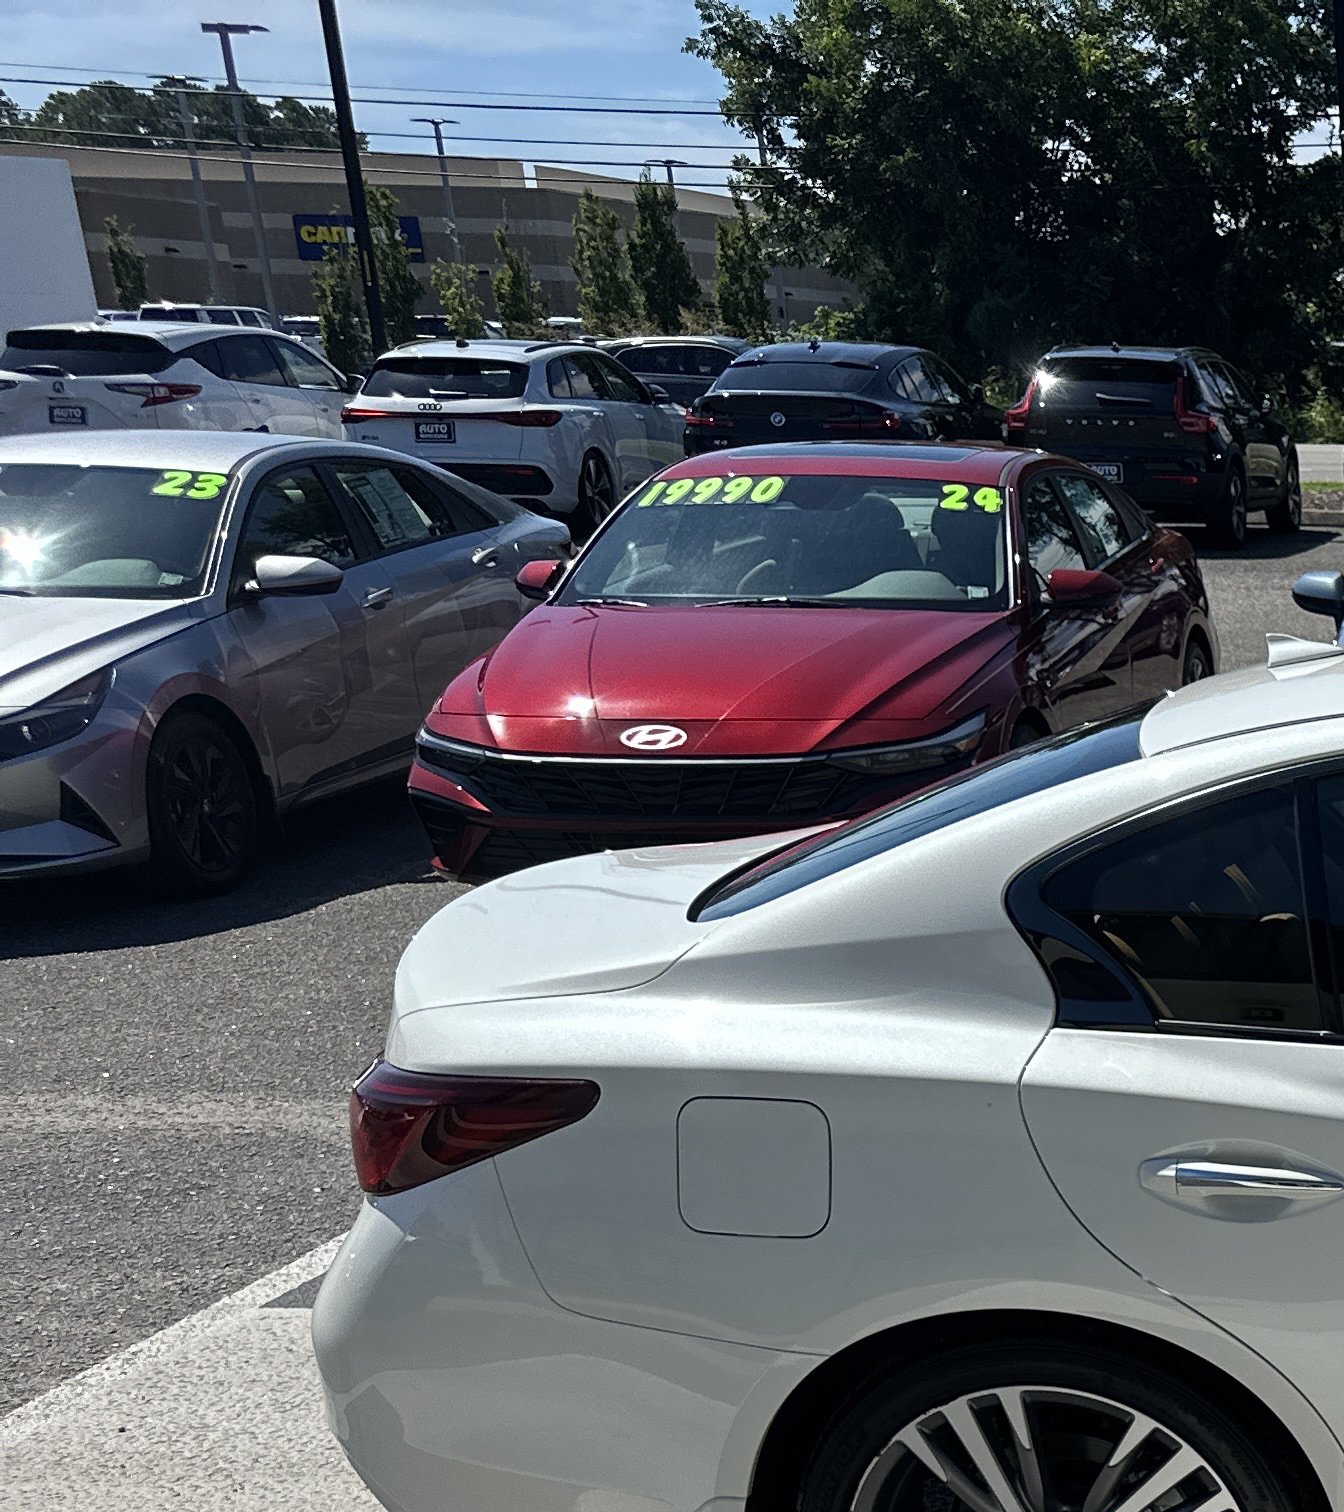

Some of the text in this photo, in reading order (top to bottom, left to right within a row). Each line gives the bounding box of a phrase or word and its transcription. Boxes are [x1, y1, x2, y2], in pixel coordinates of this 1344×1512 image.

[419, 424, 448, 434] AUTO
[152, 472, 226, 499] 23
[637, 476, 1003, 514] 19990 24
